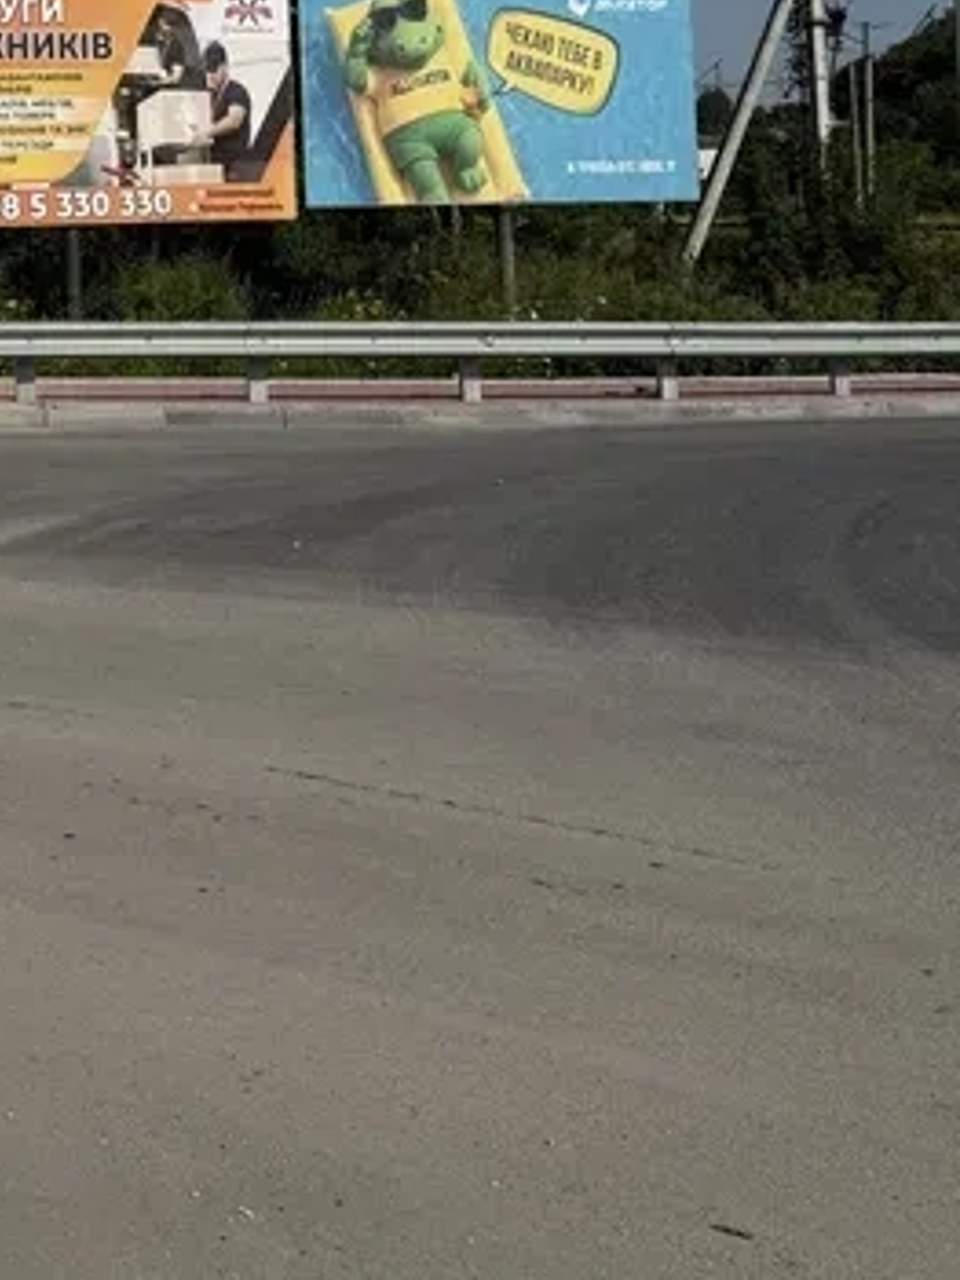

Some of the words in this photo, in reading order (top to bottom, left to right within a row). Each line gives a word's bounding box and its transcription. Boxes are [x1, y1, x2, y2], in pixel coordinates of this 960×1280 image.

[505, 21, 555, 56] ЧЕКАЮ
[557, 37, 592, 68] ТЕБЕ
[29, 193, 47, 217] 5
[56, 191, 110, 217] 330
[119, 190, 172, 215] 330
